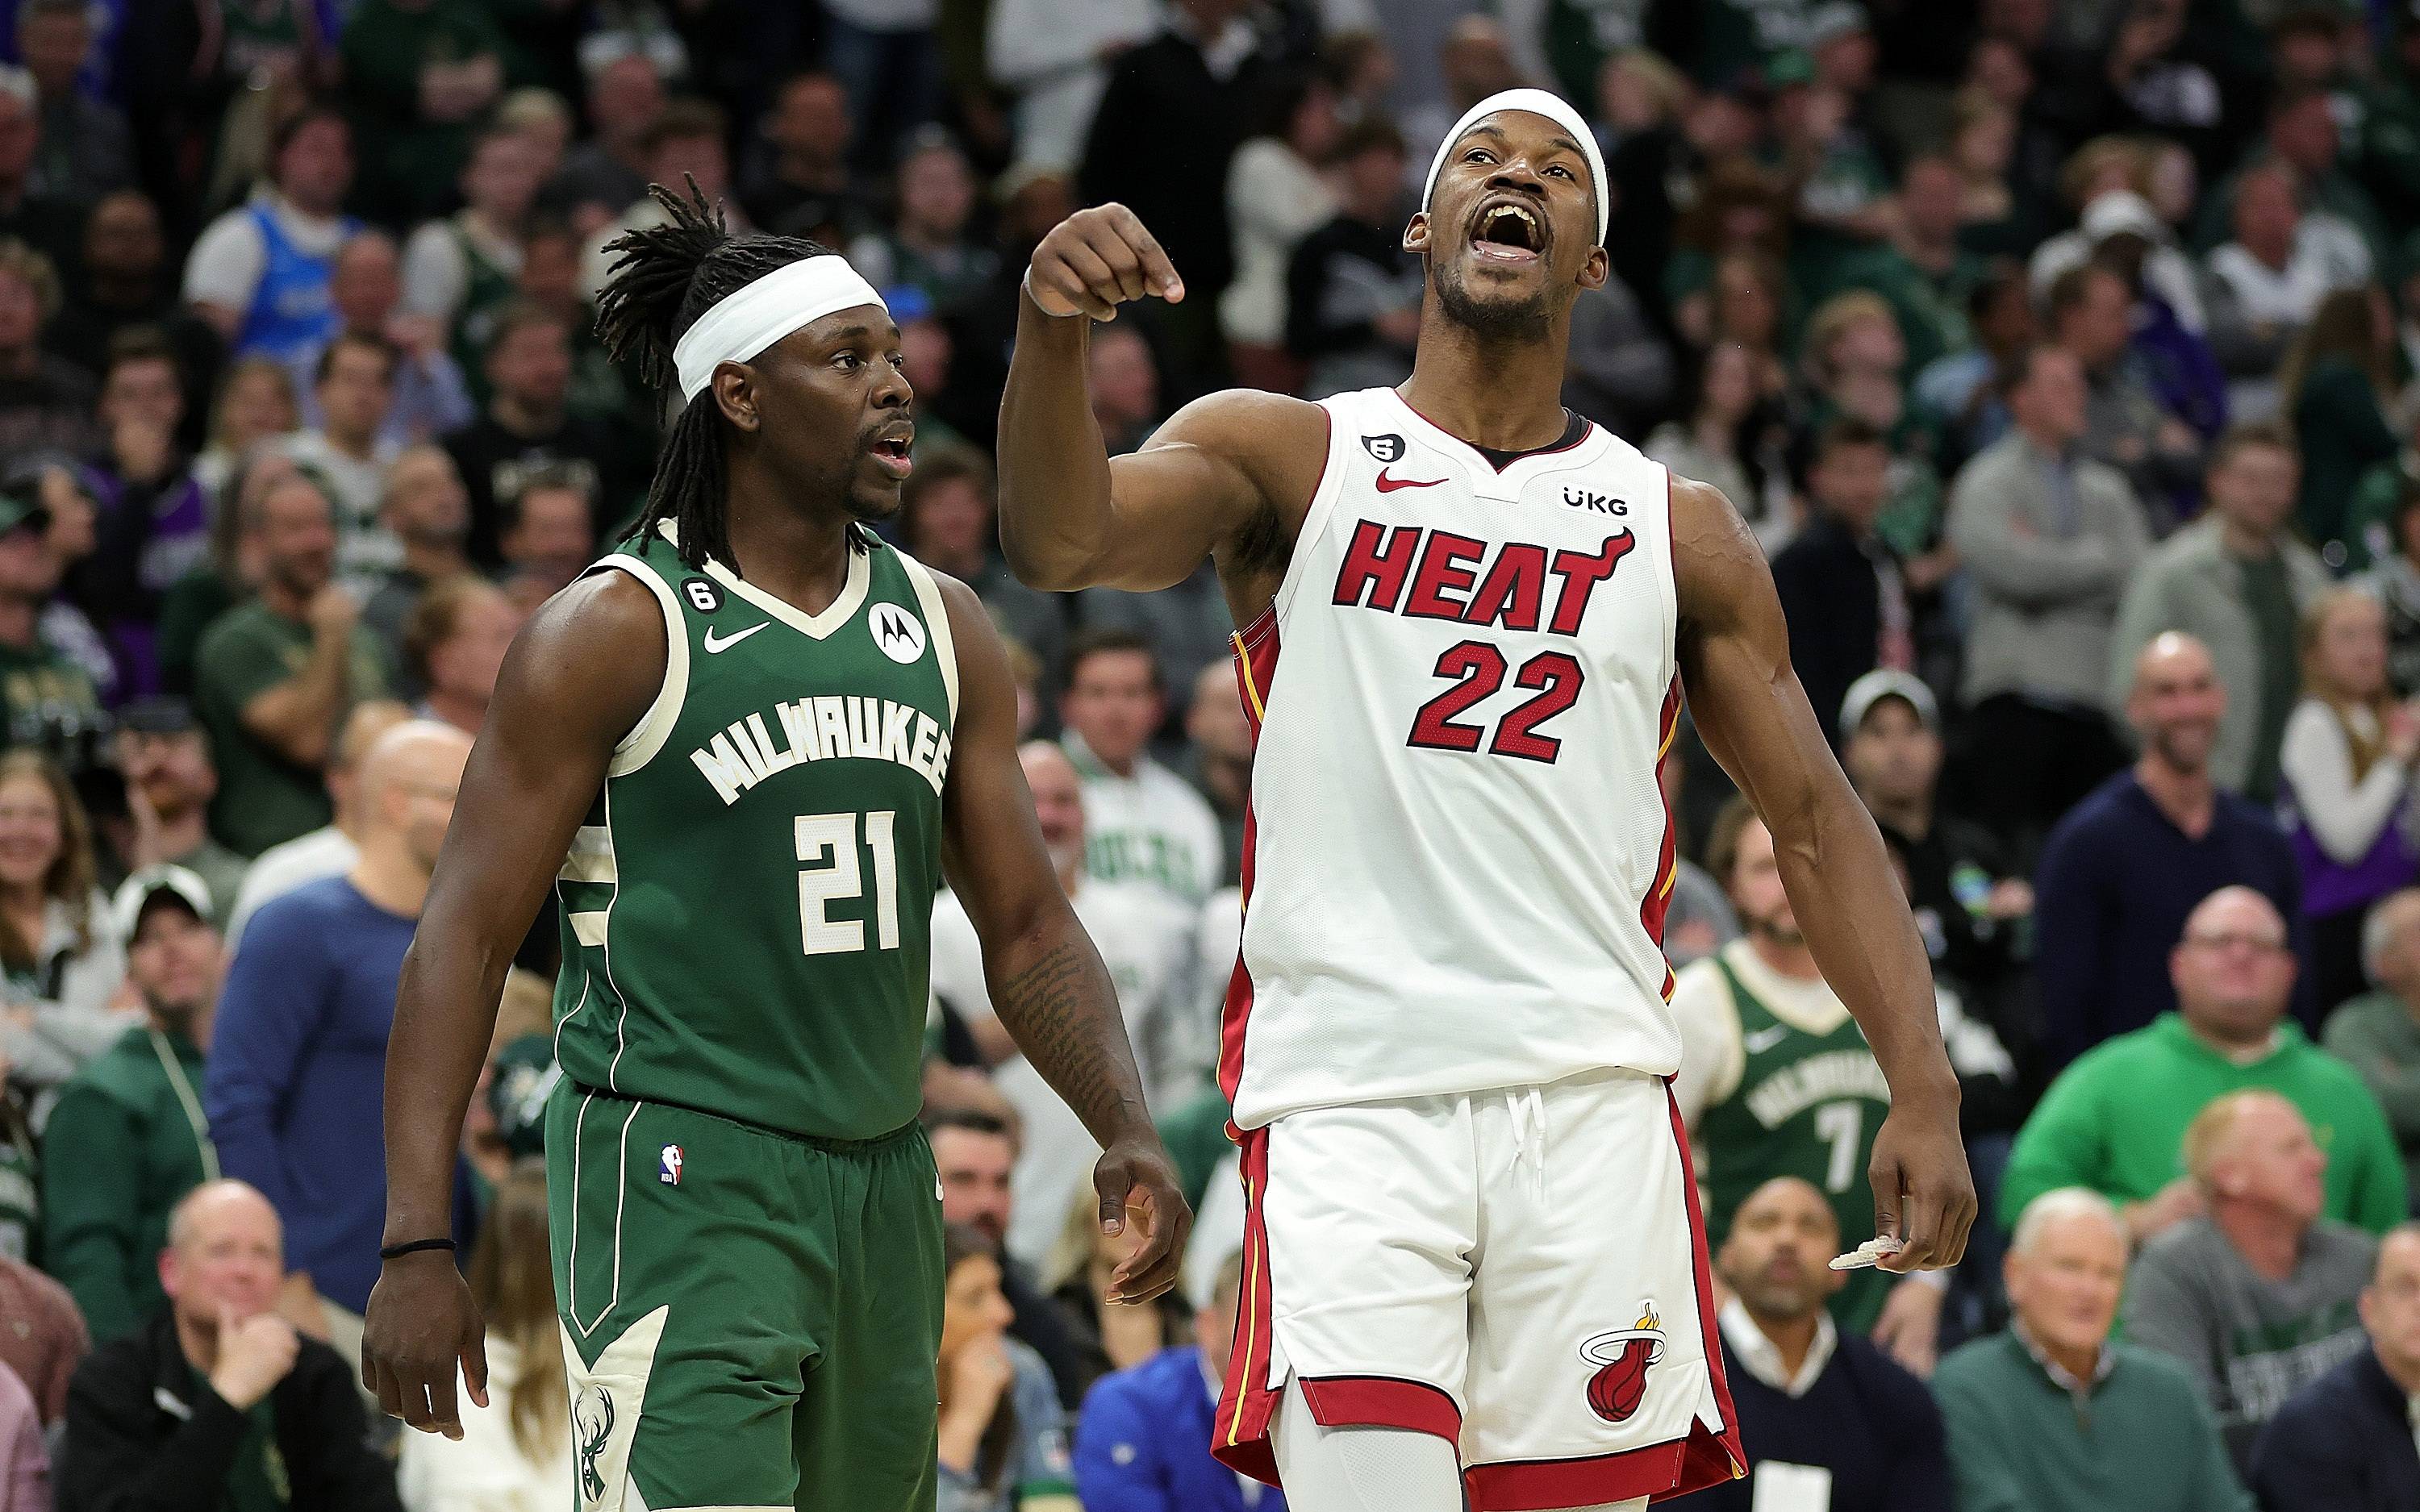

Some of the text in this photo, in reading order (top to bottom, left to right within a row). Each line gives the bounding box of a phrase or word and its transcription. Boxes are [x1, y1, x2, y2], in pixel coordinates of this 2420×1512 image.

[1369, 438, 1395, 461] 6
[686, 581, 718, 610] 6
[1332, 518, 1636, 638] HEAT
[689, 694, 953, 806] MILWAUKEE
[1405, 639, 1585, 765] 22
[793, 810, 900, 956] 21
[1817, 1100, 1863, 1194] 7
